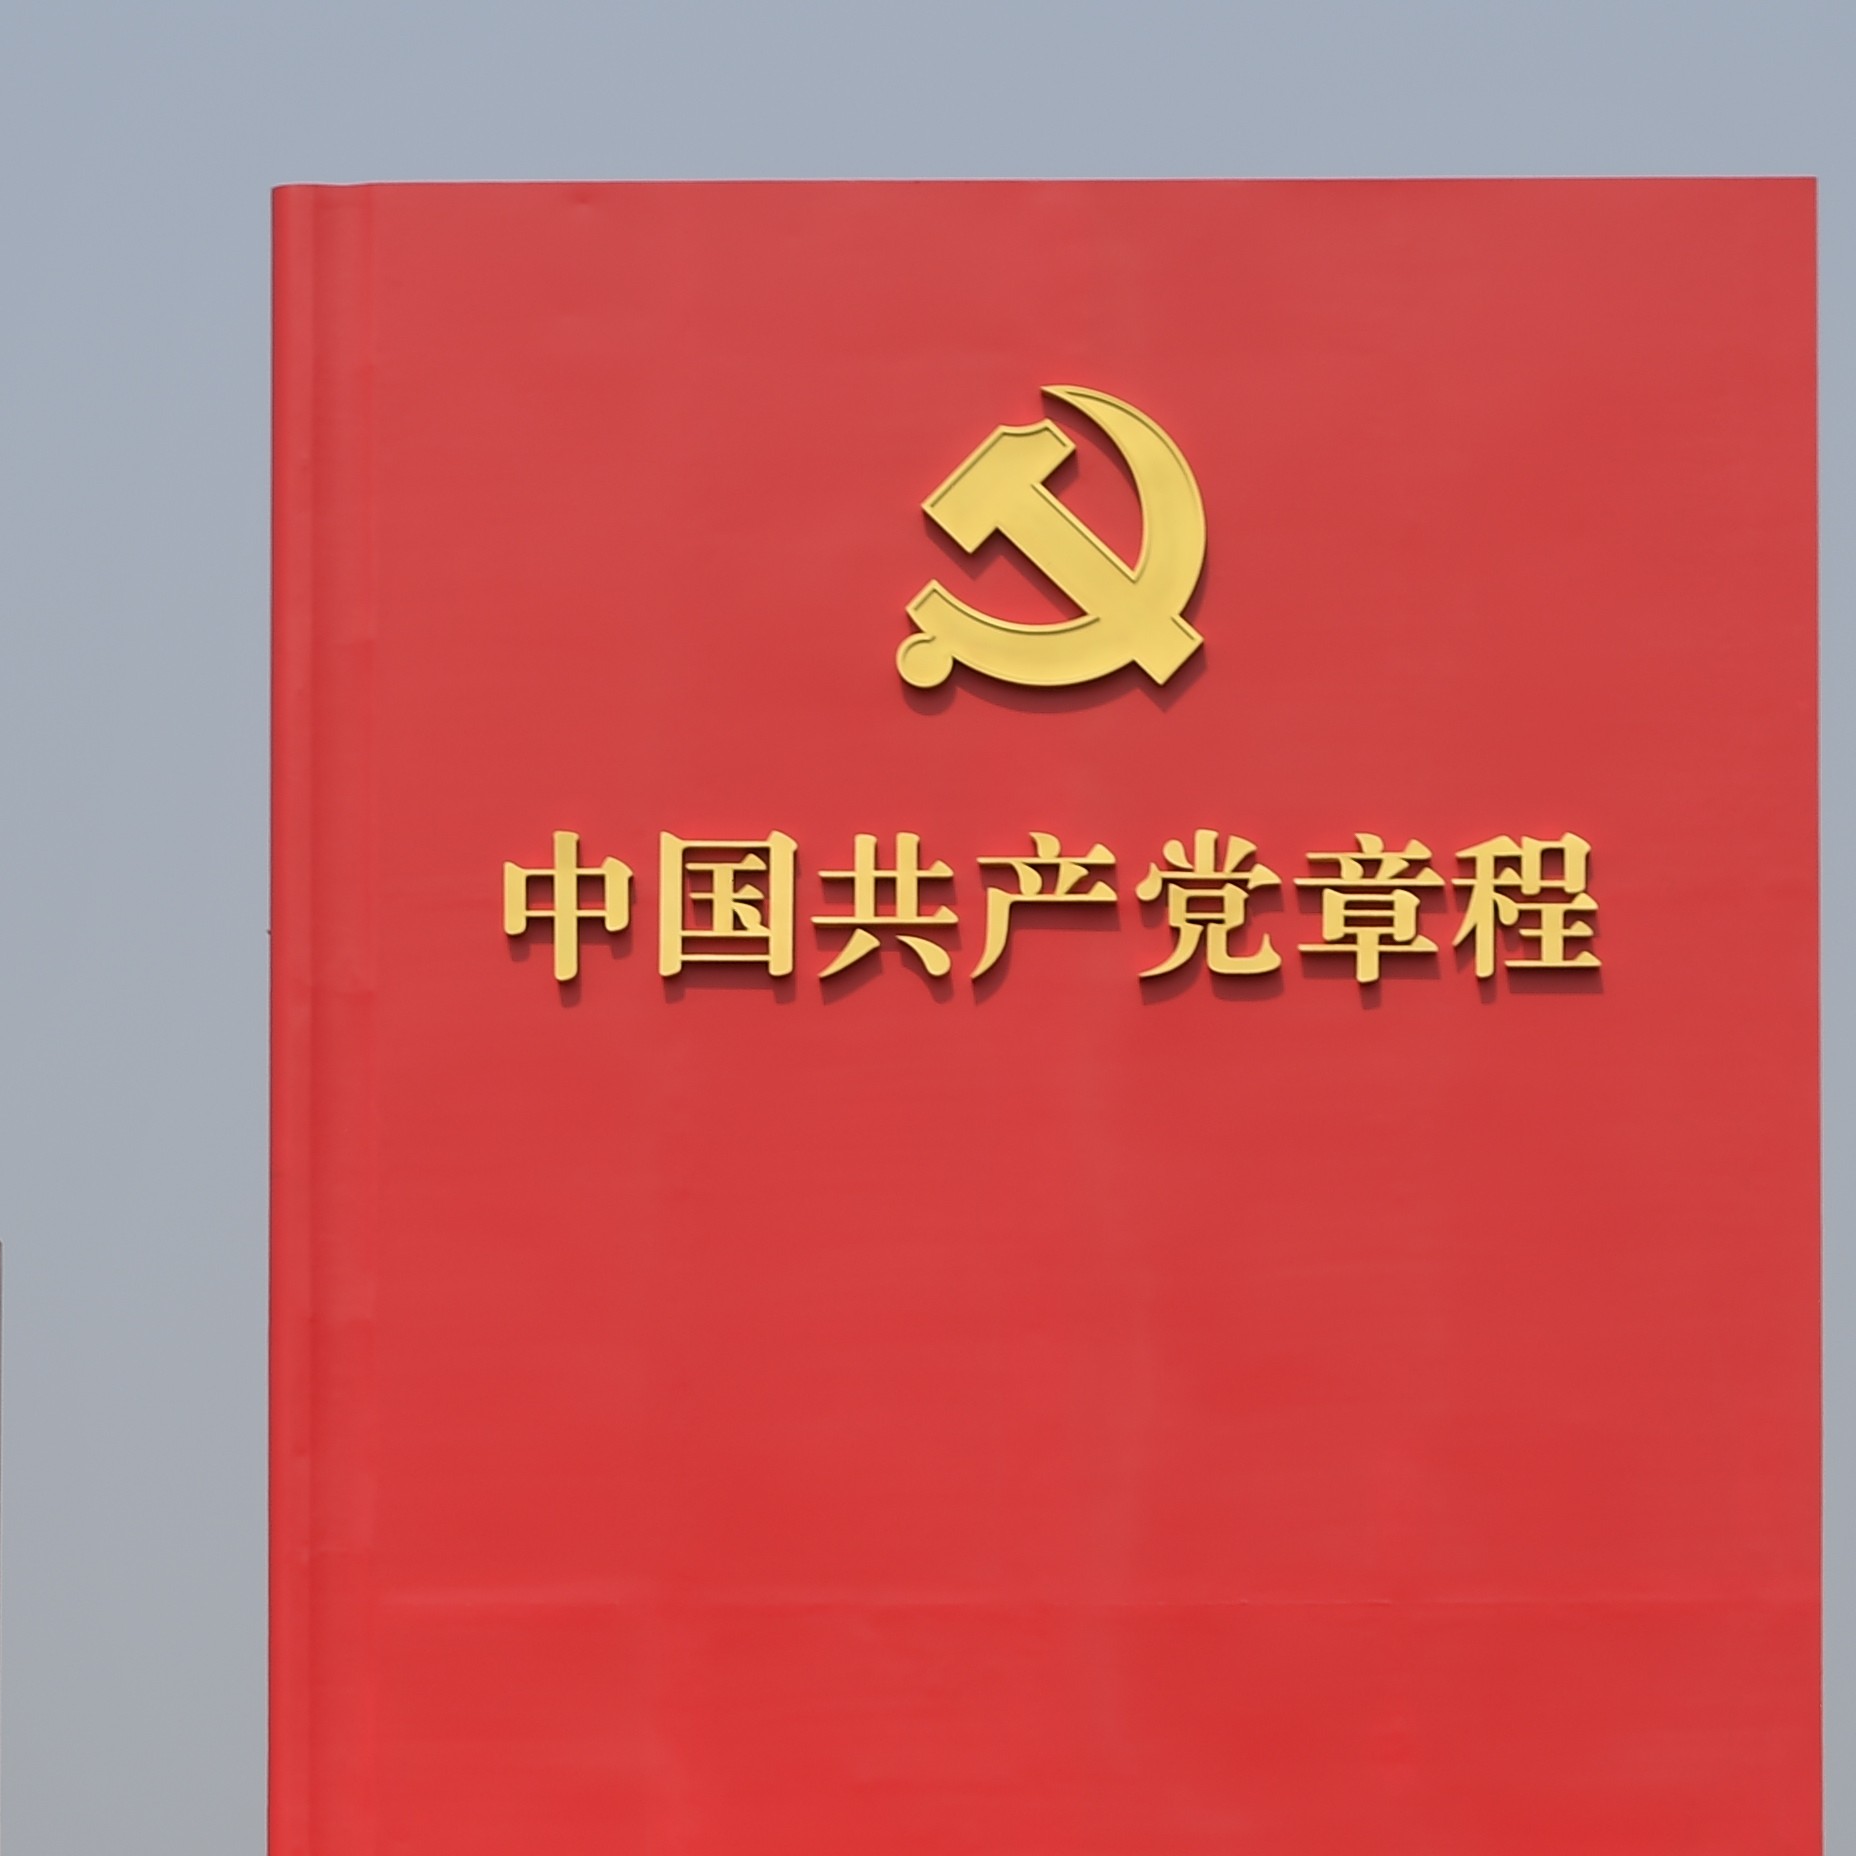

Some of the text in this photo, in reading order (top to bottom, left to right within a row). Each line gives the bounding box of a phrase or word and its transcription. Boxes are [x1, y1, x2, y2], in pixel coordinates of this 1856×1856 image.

[502, 829, 1603, 983] 中国共产党章程
